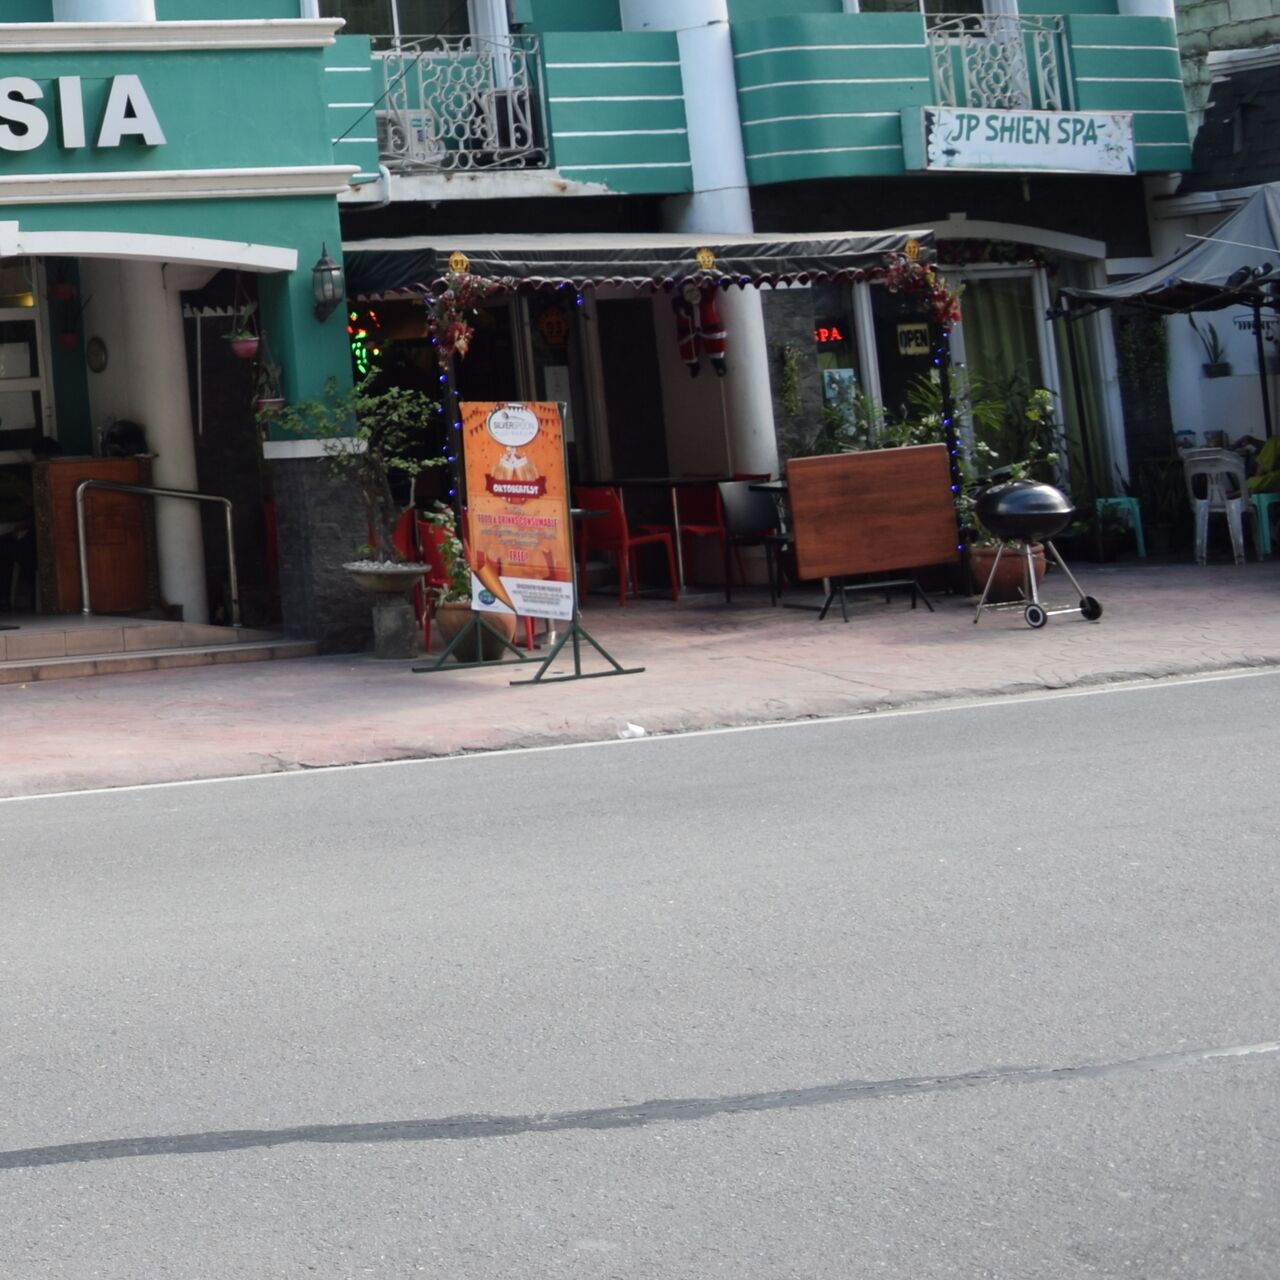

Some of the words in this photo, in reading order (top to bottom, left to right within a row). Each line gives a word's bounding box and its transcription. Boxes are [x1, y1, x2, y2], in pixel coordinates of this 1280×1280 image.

[951, 113, 980, 142] JP
[985, 115, 1050, 144] SHIEN
[1057, 118, 1099, 146] SPA
[900, 328, 929, 349] OPEN
